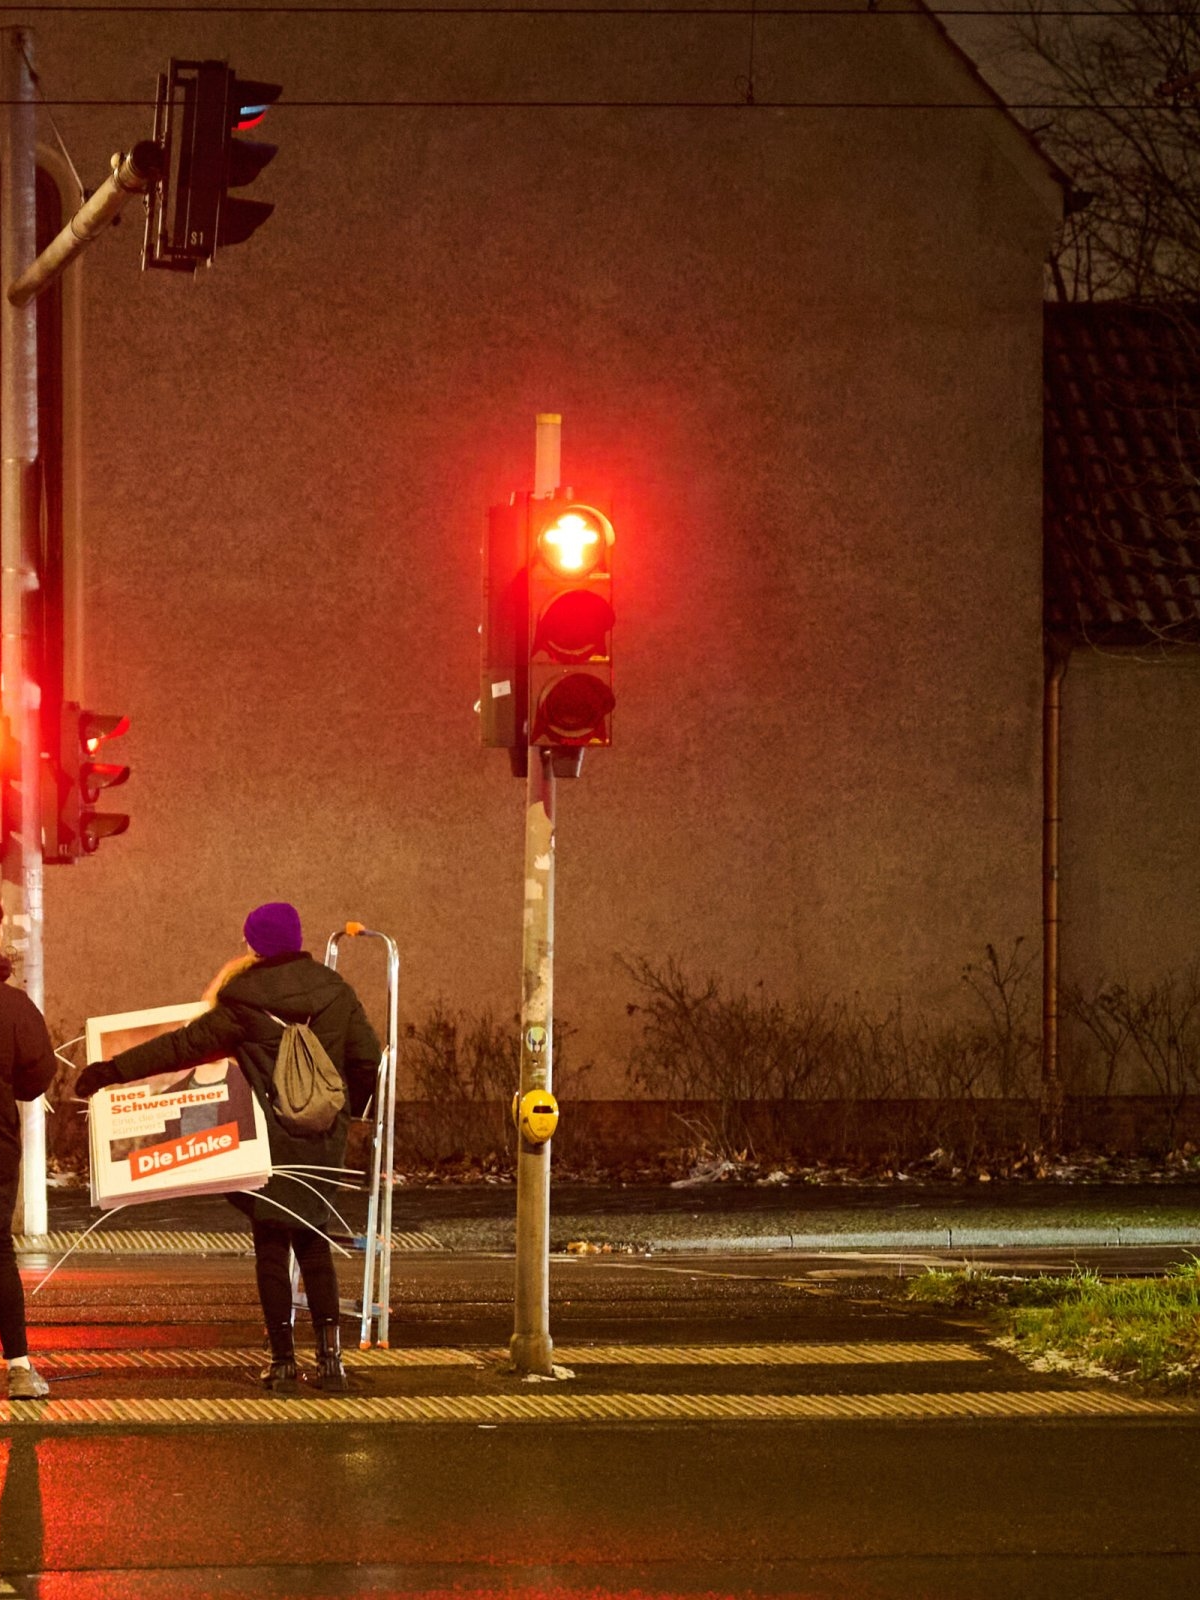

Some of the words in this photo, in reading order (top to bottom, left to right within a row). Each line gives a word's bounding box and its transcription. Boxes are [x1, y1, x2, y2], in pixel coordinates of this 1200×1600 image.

[110, 1089, 146, 1103] Ines
[110, 1089, 224, 1115] Schwerdtner
[138, 1151, 174, 1174] Die
[175, 1134, 233, 1162] Linke
